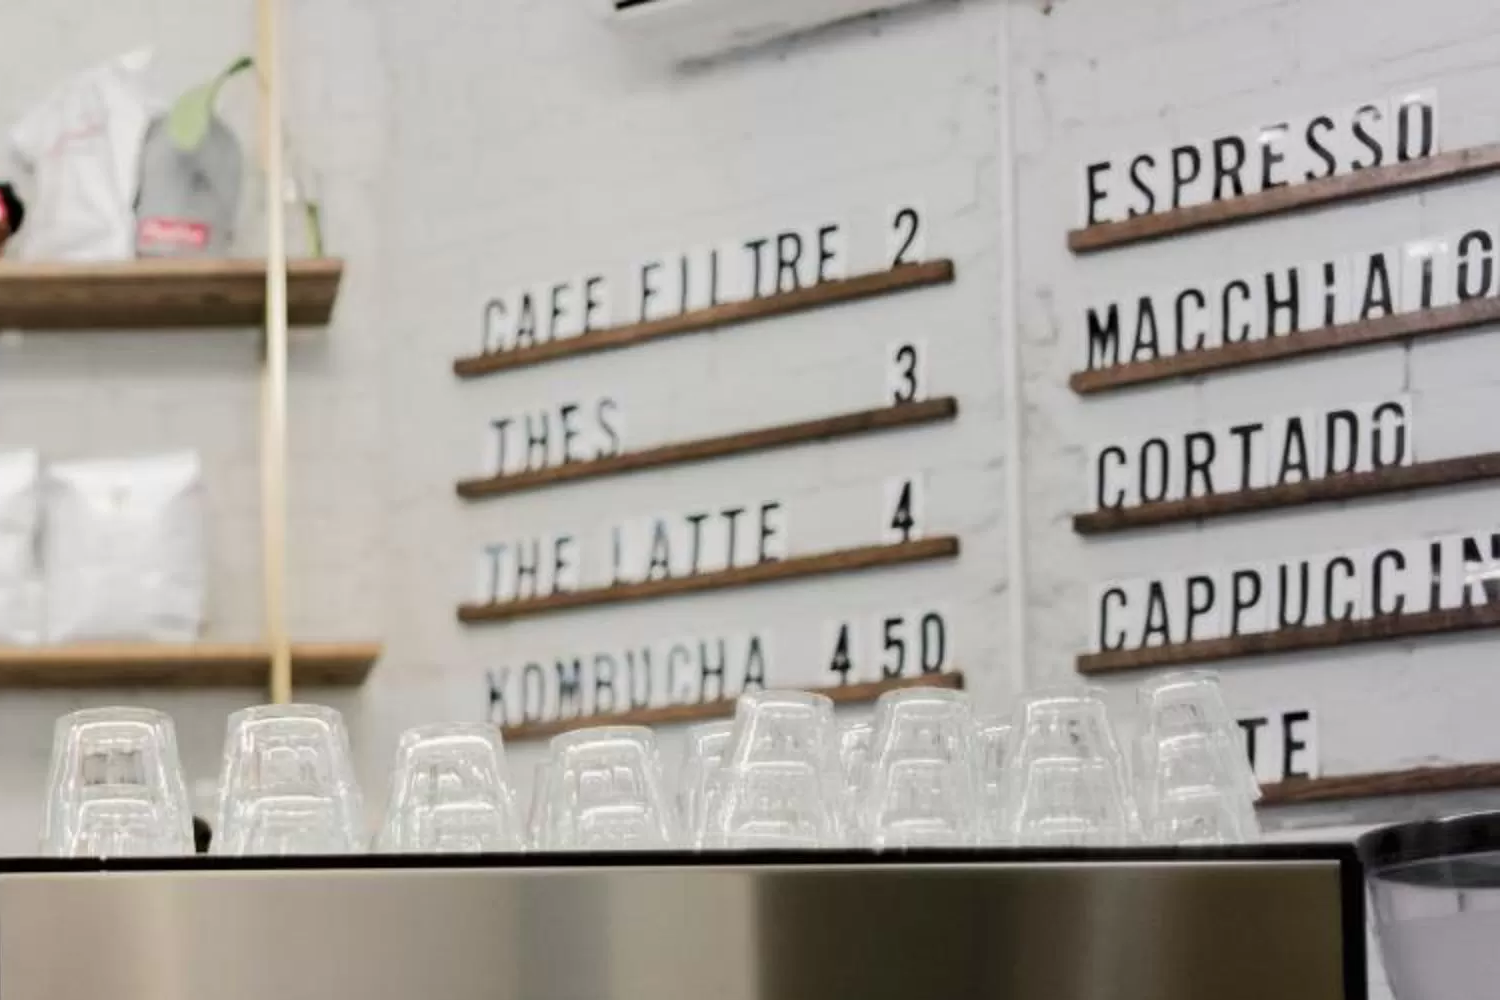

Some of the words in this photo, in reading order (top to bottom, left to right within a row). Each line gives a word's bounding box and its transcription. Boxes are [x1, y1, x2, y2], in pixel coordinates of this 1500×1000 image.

[1086, 101, 1433, 226] ESPRESSO
[890, 207, 920, 269] 2
[489, 396, 621, 477] THES
[894, 345, 918, 405] 3
[1097, 401, 1406, 512] CORTADO
[483, 535, 575, 606] THE
[610, 501, 781, 585] LATTE
[890, 480, 916, 542] 4
[485, 635, 767, 725] KOMBUCHA
